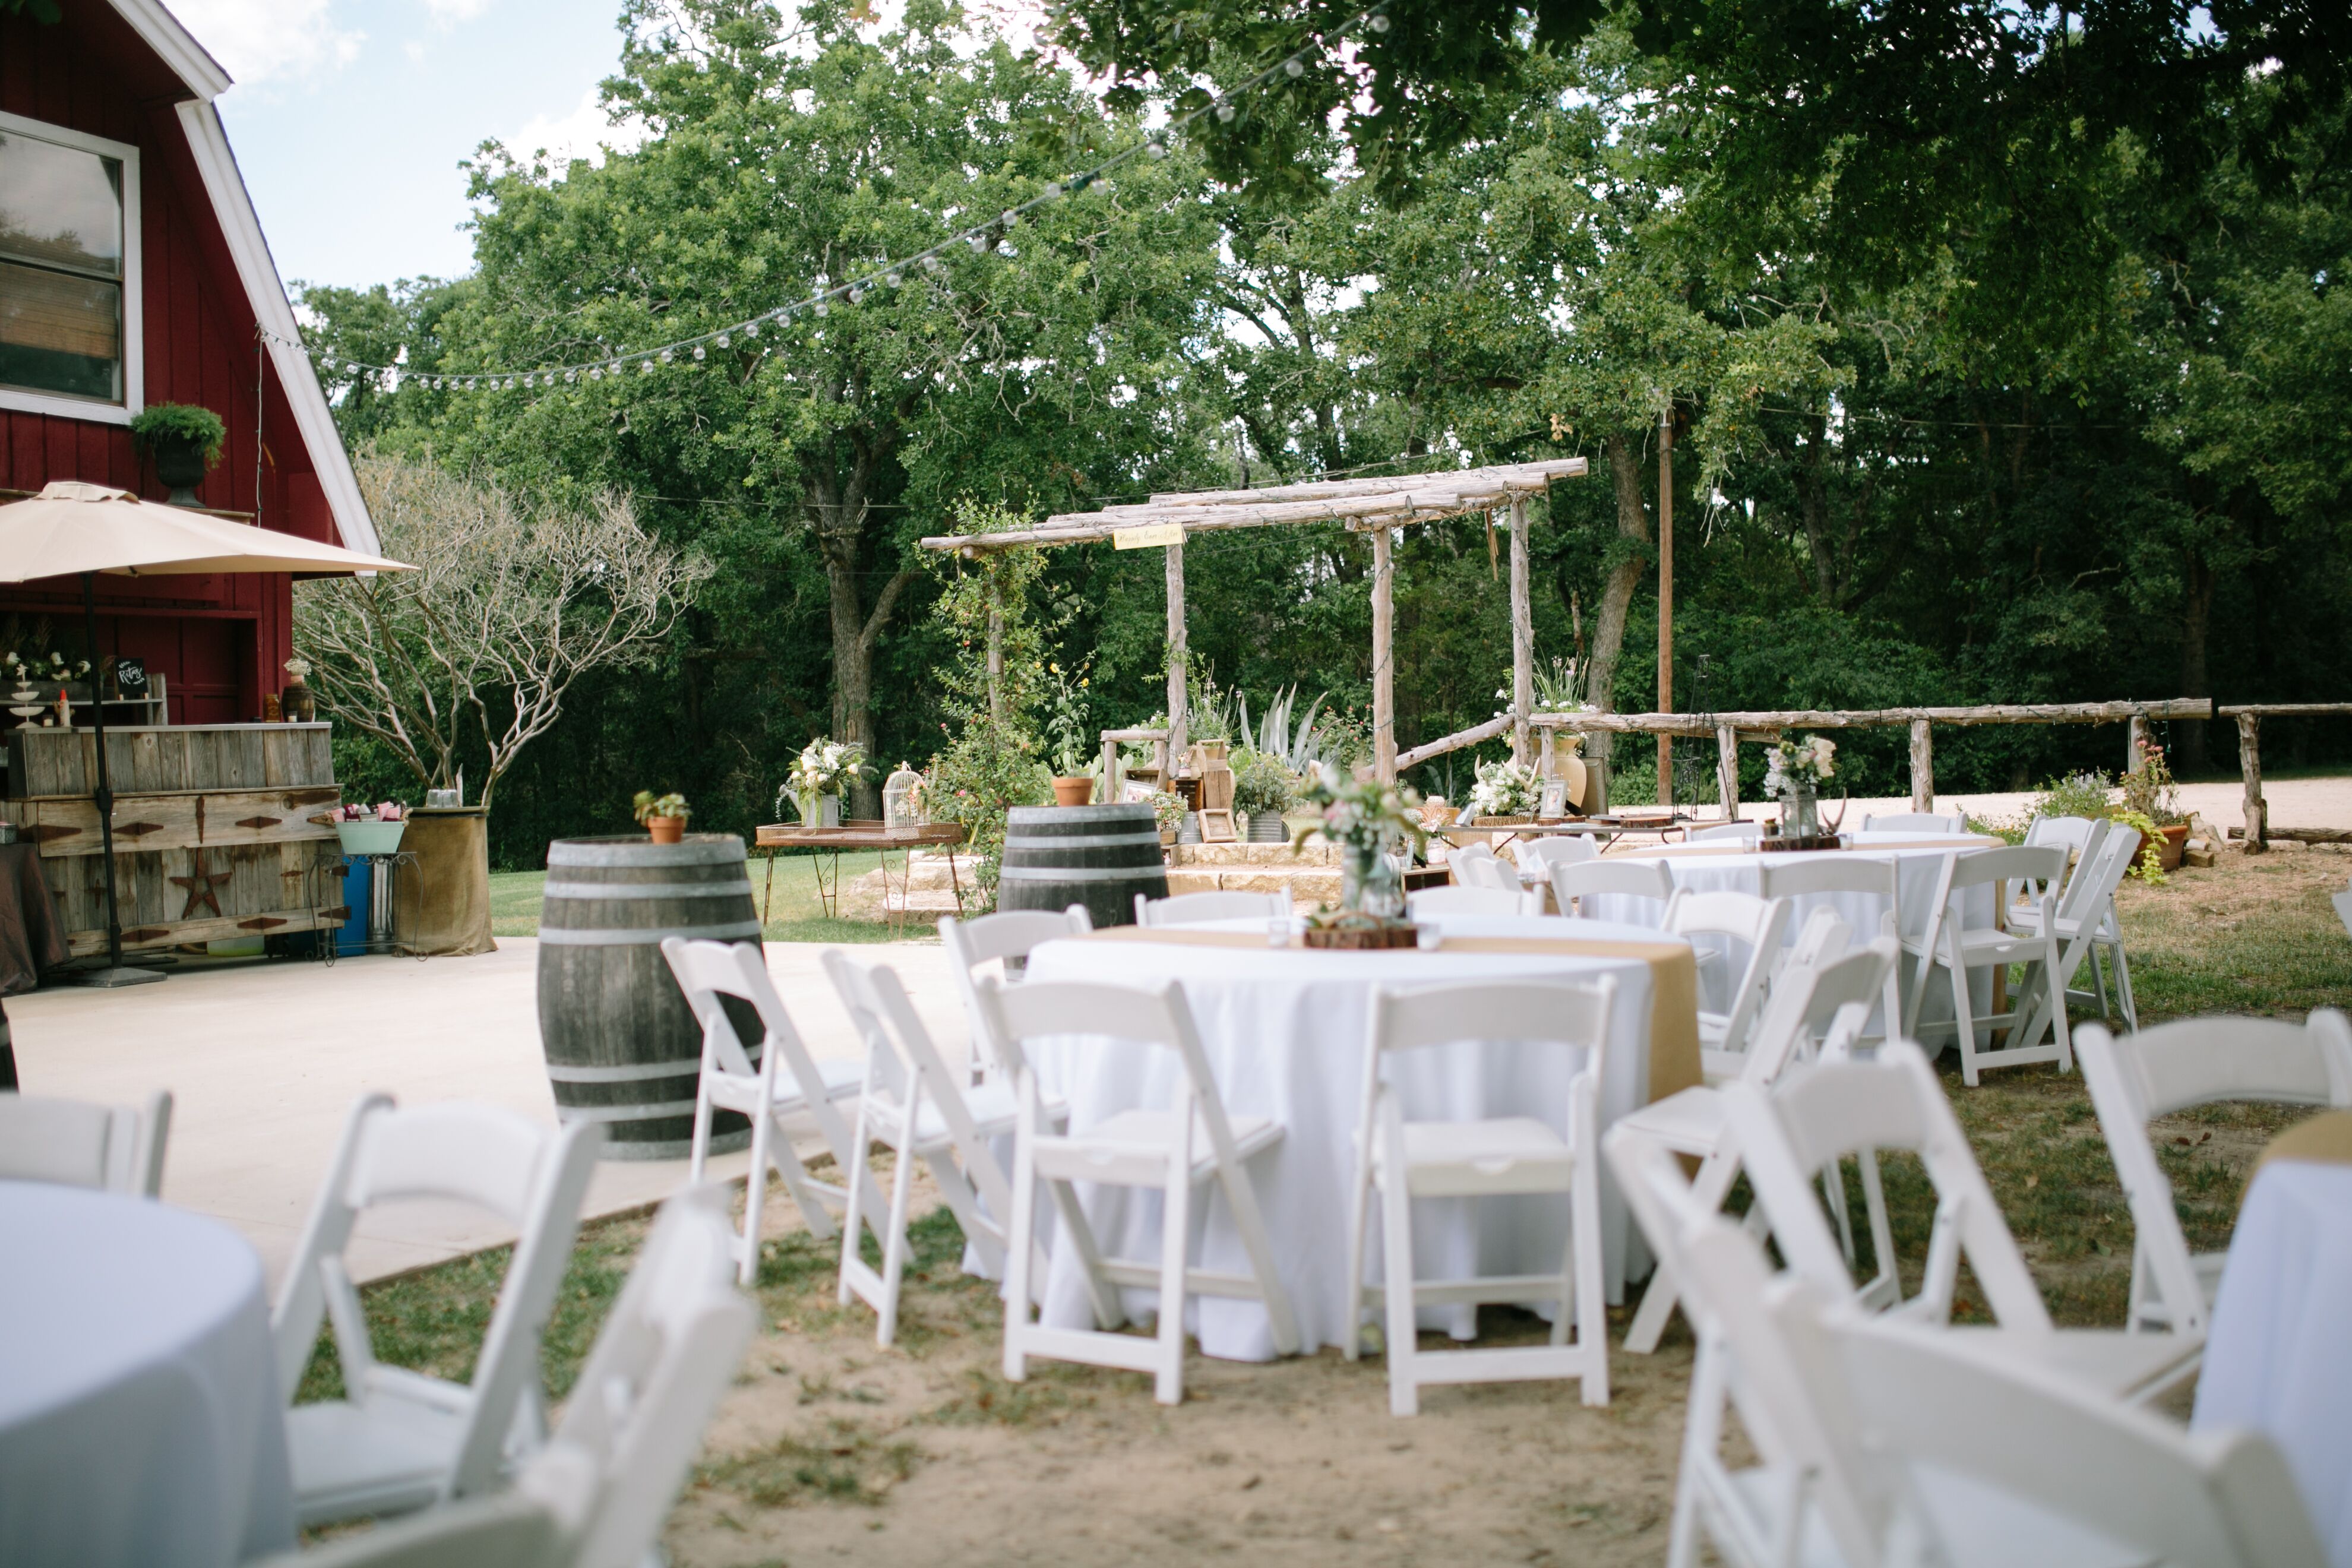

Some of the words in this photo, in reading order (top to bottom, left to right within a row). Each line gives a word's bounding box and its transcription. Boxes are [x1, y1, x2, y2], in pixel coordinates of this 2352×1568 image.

[1118, 532, 1140, 545] Happily
[1144, 530, 1157, 539] Ever
[1159, 528, 1178, 540] After
[119, 666, 142, 684] Ritas
